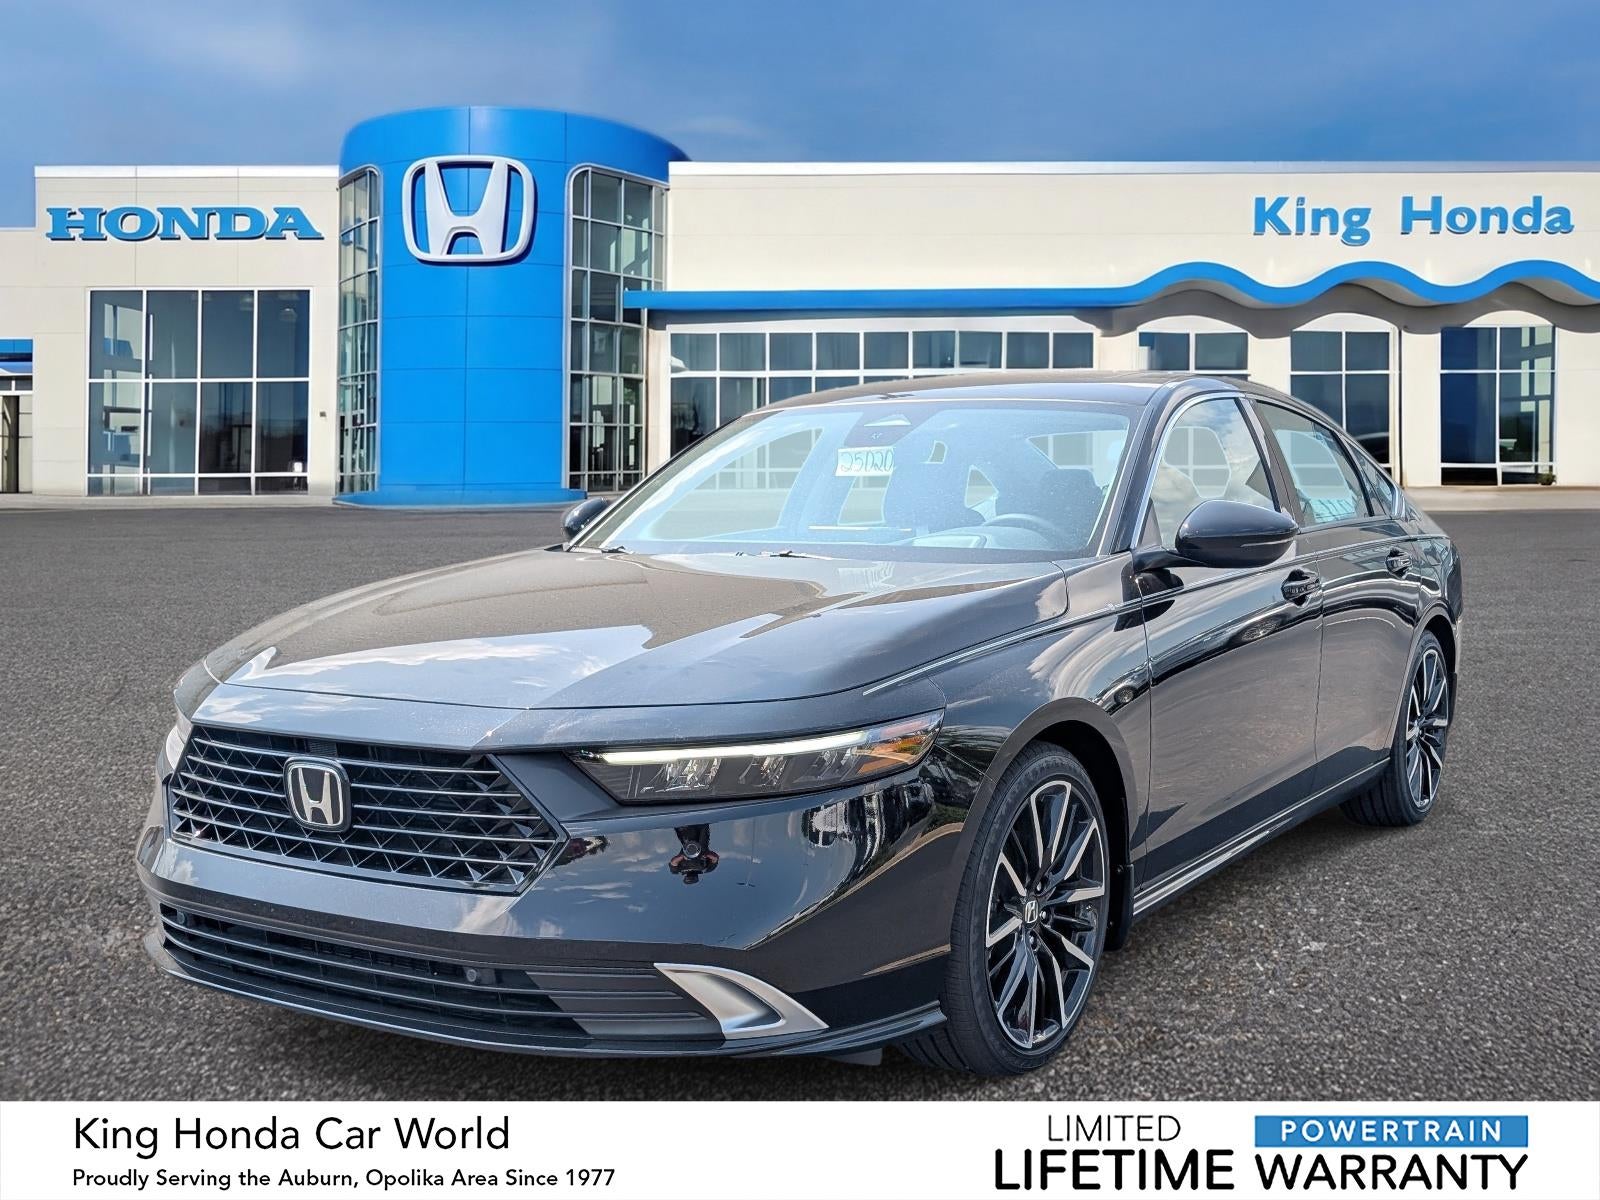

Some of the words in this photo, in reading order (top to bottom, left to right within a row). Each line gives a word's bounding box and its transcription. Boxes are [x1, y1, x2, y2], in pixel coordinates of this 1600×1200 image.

[46, 206, 323, 241] HONDA
[1253, 195, 1371, 245] King
[1401, 195, 1575, 234] Honda
[839, 449, 894, 473] 25020
